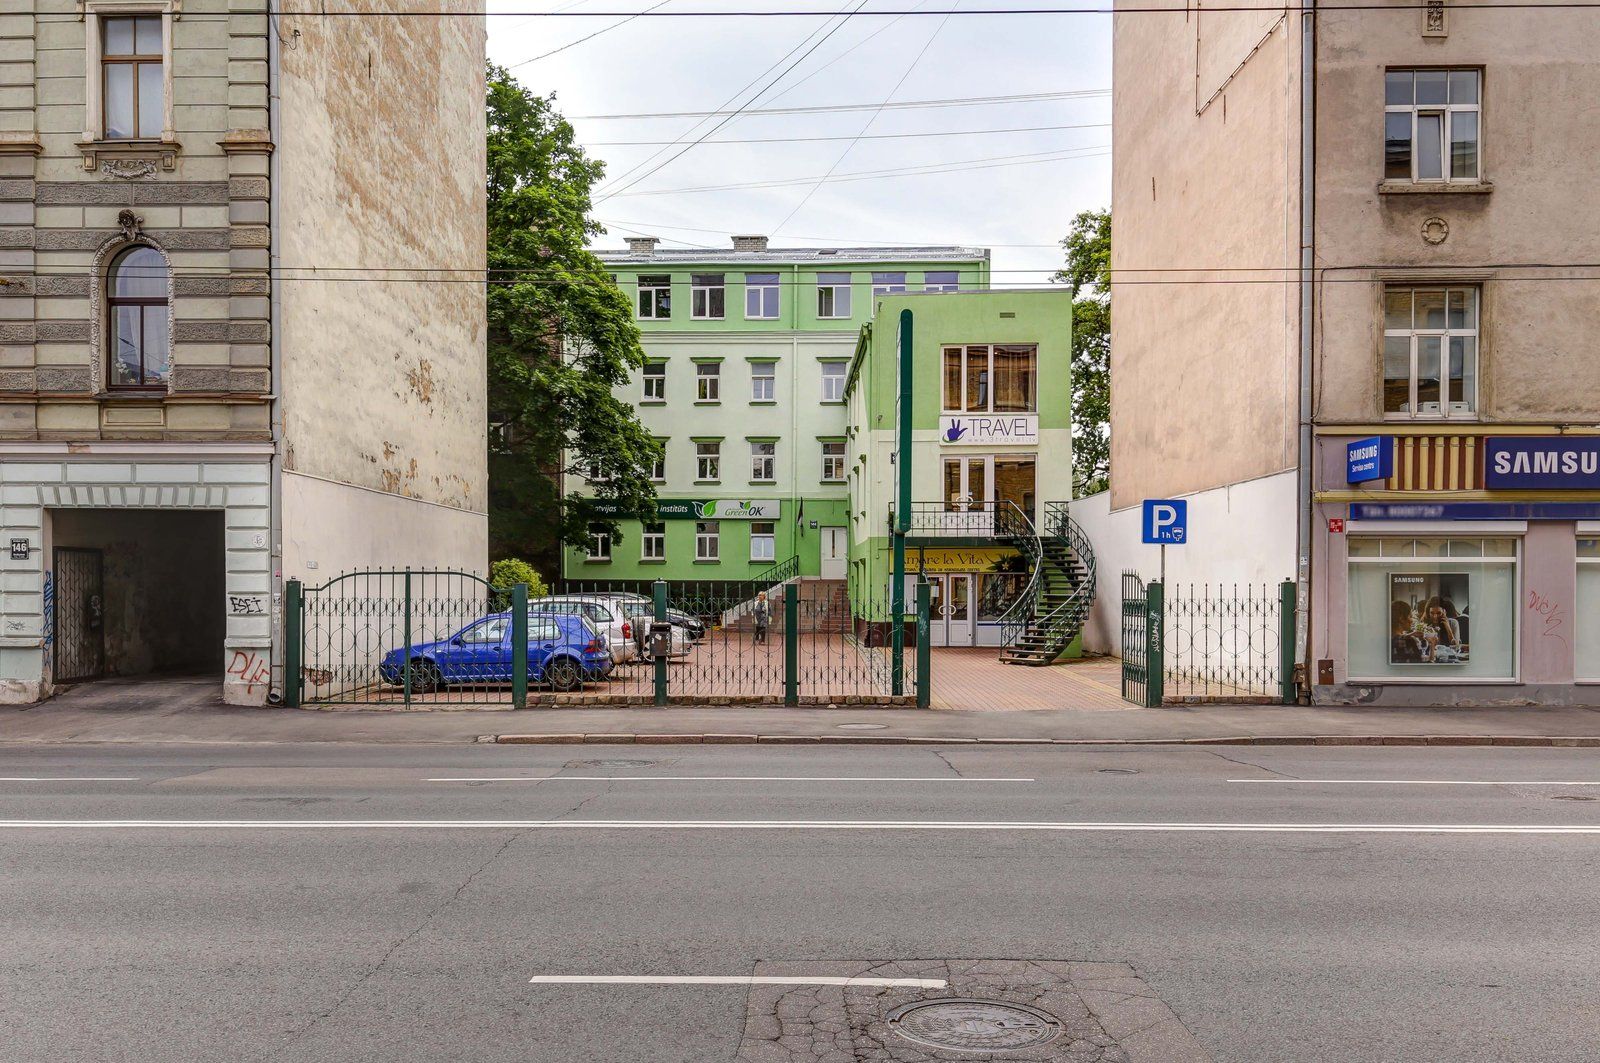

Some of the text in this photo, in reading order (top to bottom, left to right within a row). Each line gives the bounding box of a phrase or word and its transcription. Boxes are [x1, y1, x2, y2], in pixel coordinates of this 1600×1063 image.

[968, 418, 1035, 436] TRAVEL
[1350, 445, 1377, 462] SAMSUNG
[1494, 451, 1598, 474] SAMSU
[660, 505, 688, 513] institūts
[1153, 505, 1177, 538] P
[12, 543, 27, 552] 146
[957, 553, 985, 565] Vita
